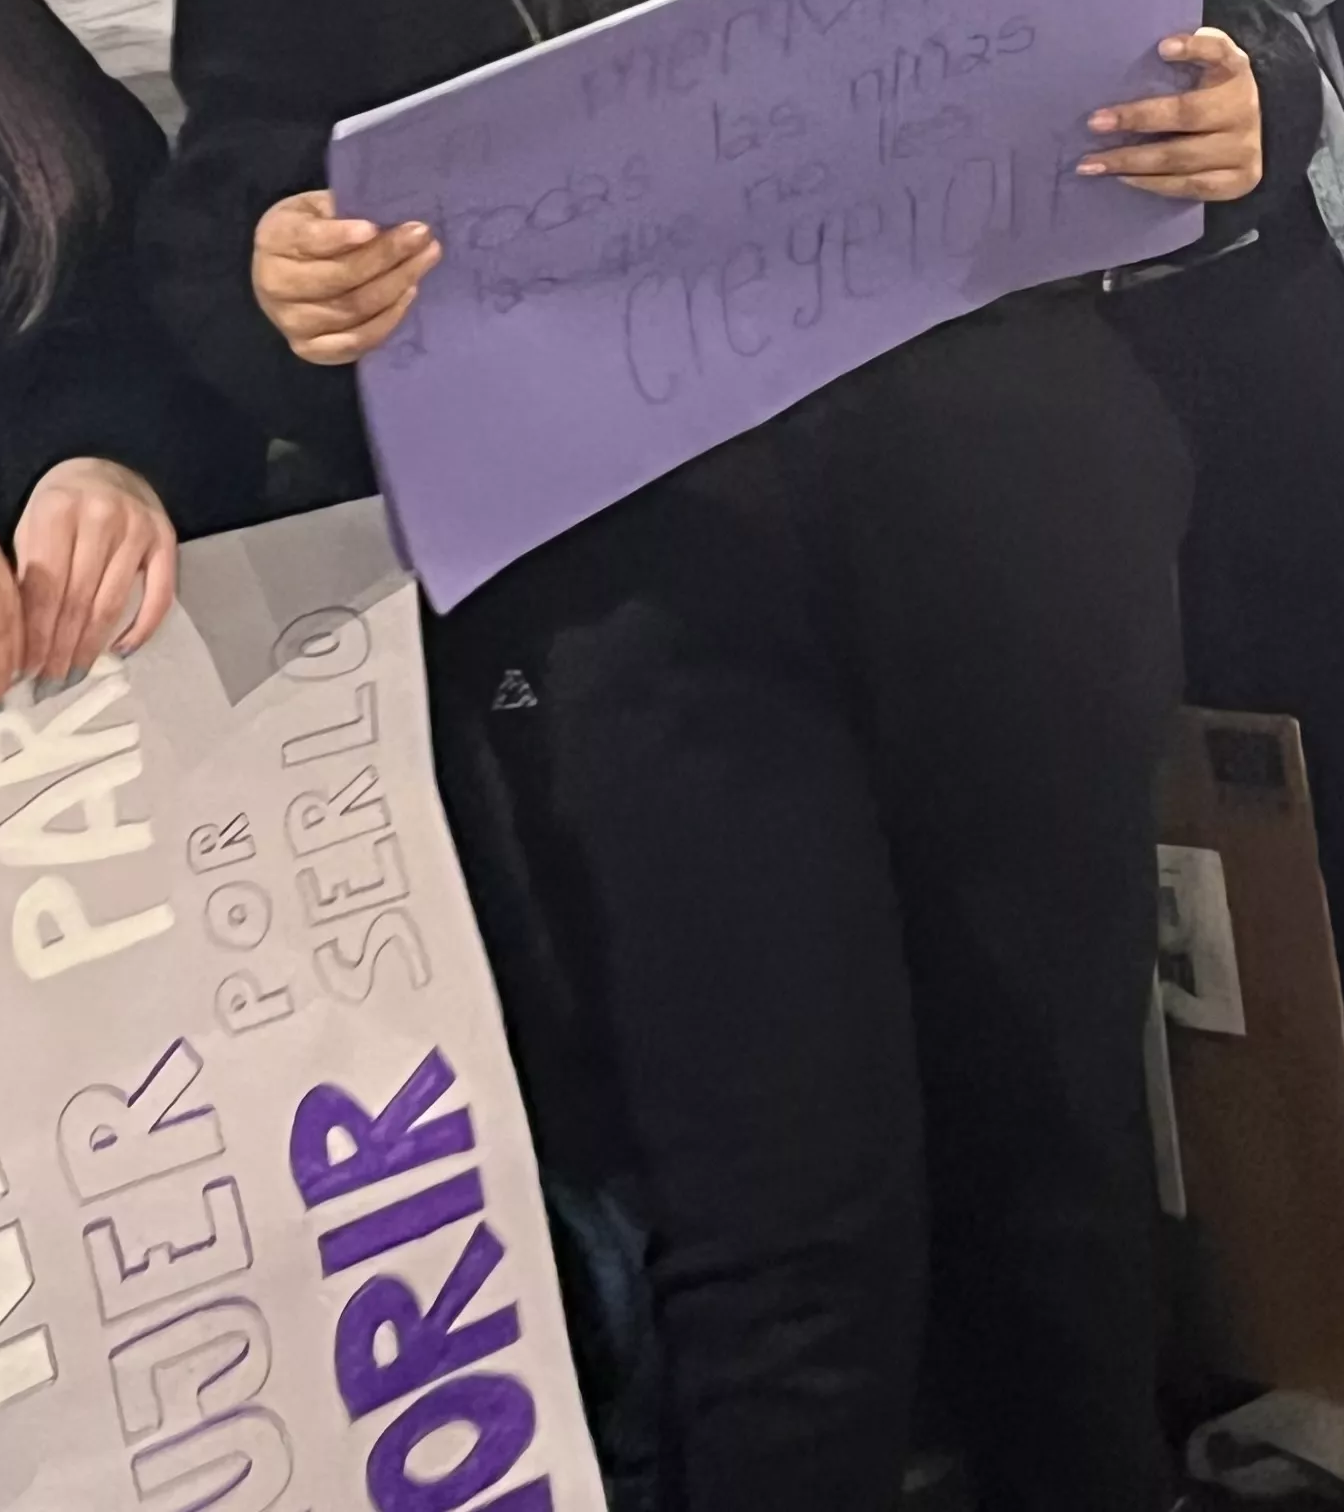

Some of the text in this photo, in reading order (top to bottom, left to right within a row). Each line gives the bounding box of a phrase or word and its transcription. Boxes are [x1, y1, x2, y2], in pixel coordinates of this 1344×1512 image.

[186, 811, 296, 1038] POR
[56, 1036, 298, 1512] UJER
[288, 1045, 556, 1512] ORIR
